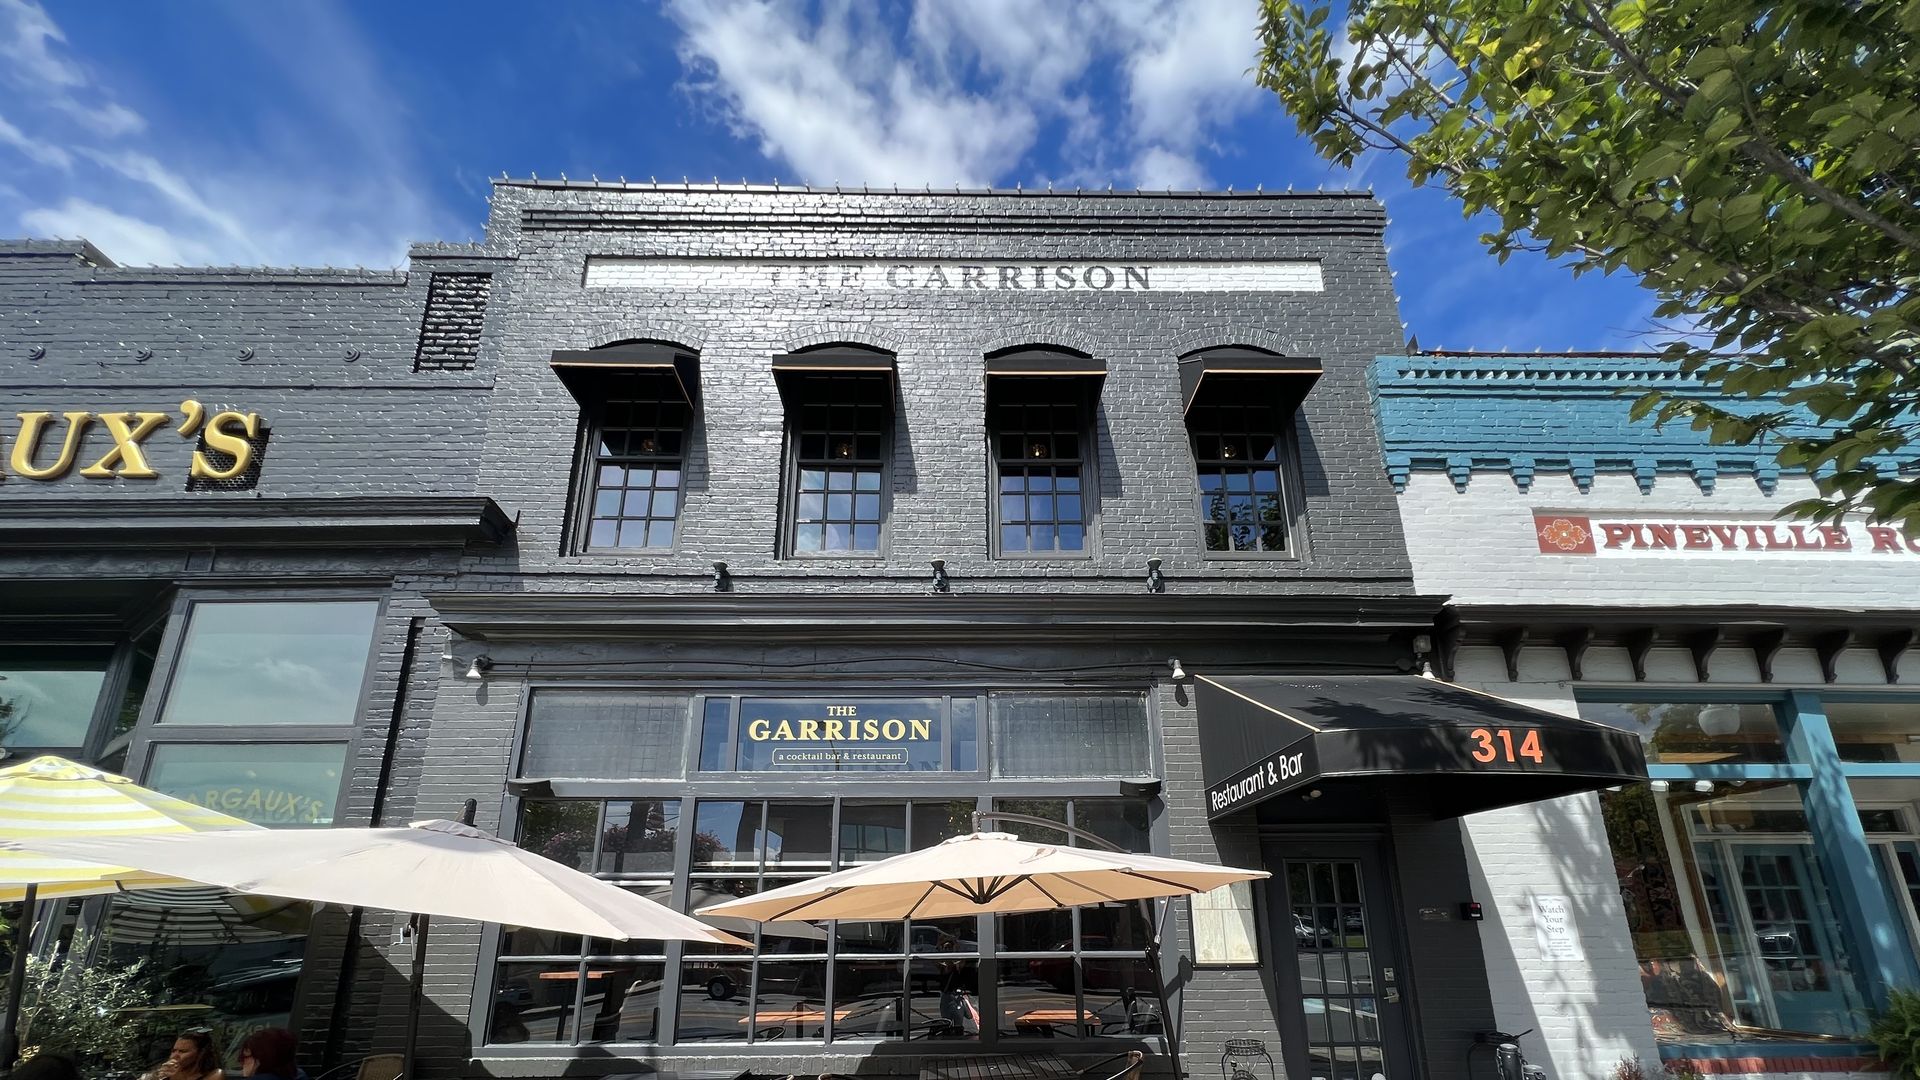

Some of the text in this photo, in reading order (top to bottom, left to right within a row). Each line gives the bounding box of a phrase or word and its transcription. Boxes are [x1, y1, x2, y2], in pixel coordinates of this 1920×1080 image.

[762, 264, 1153, 290] THE GARRISON
[0, 399, 261, 480] UX'S
[1599, 522, 1853, 553] PINEVILLE
[826, 705, 857, 717] THE
[749, 719, 932, 741] GARRISON
[786, 752, 823, 761] cocktail
[825, 752, 841, 761] bar
[843, 752, 850, 761] &
[852, 752, 902, 761] restaurant
[1470, 728, 1544, 764] 314
[1211, 752, 1303, 812] Restaurant & Bar
[184, 786, 324, 824] ARGAUX'S
[1538, 905, 1565, 914] Watch
[1543, 915, 1563, 923] Your
[1546, 925, 1565, 934] Step
